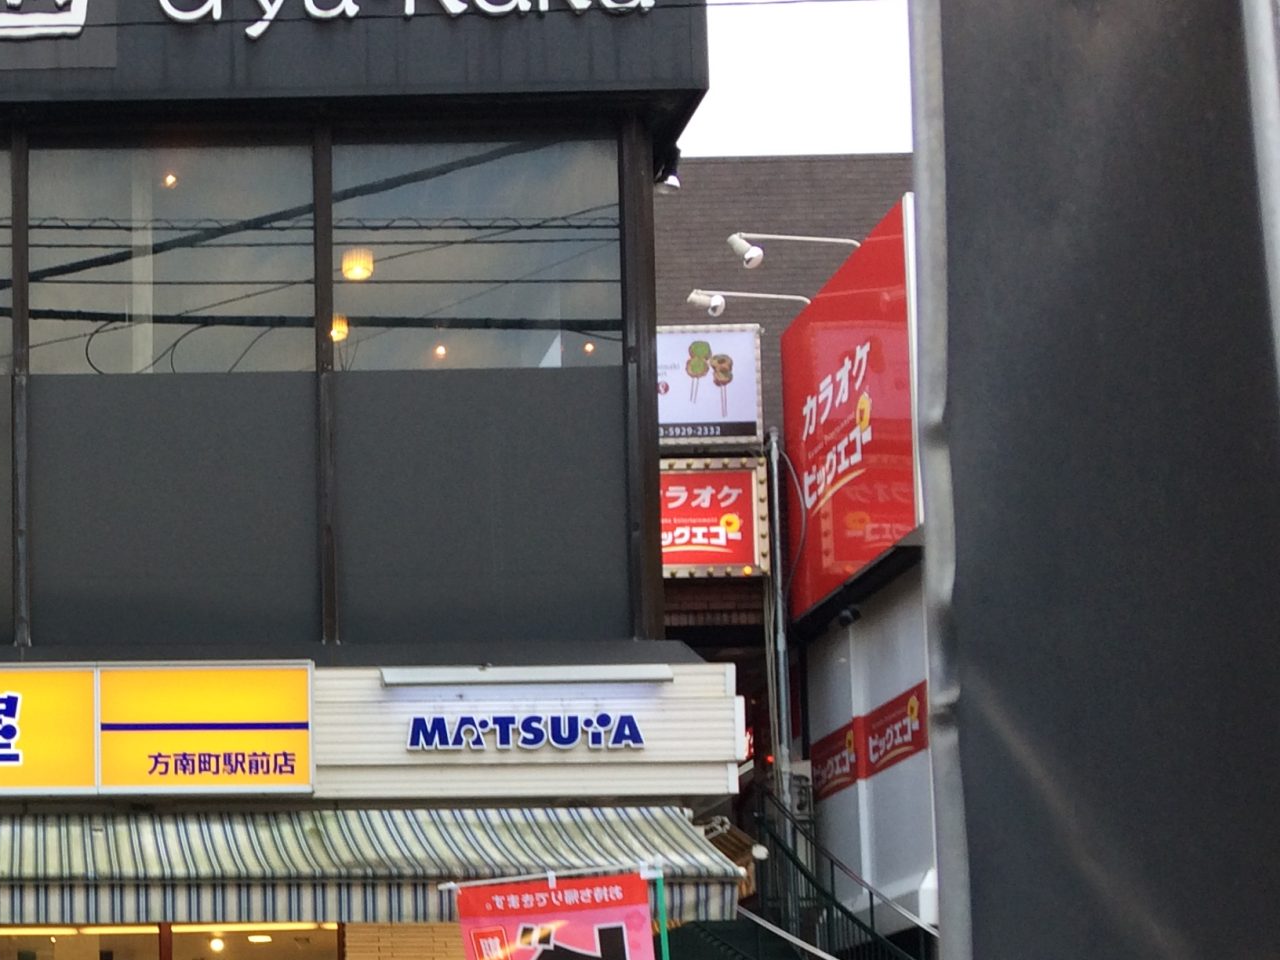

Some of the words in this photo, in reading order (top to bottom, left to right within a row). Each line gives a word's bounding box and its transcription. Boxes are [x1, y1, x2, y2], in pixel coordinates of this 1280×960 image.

[802, 341, 870, 441] カラオケ
[804, 425, 872, 509] ビッグエコー
[660, 485, 742, 509] ラオケ
[409, 713, 645, 748] MATSUYA
[148, 752, 296, 776] 方南町駅前店
